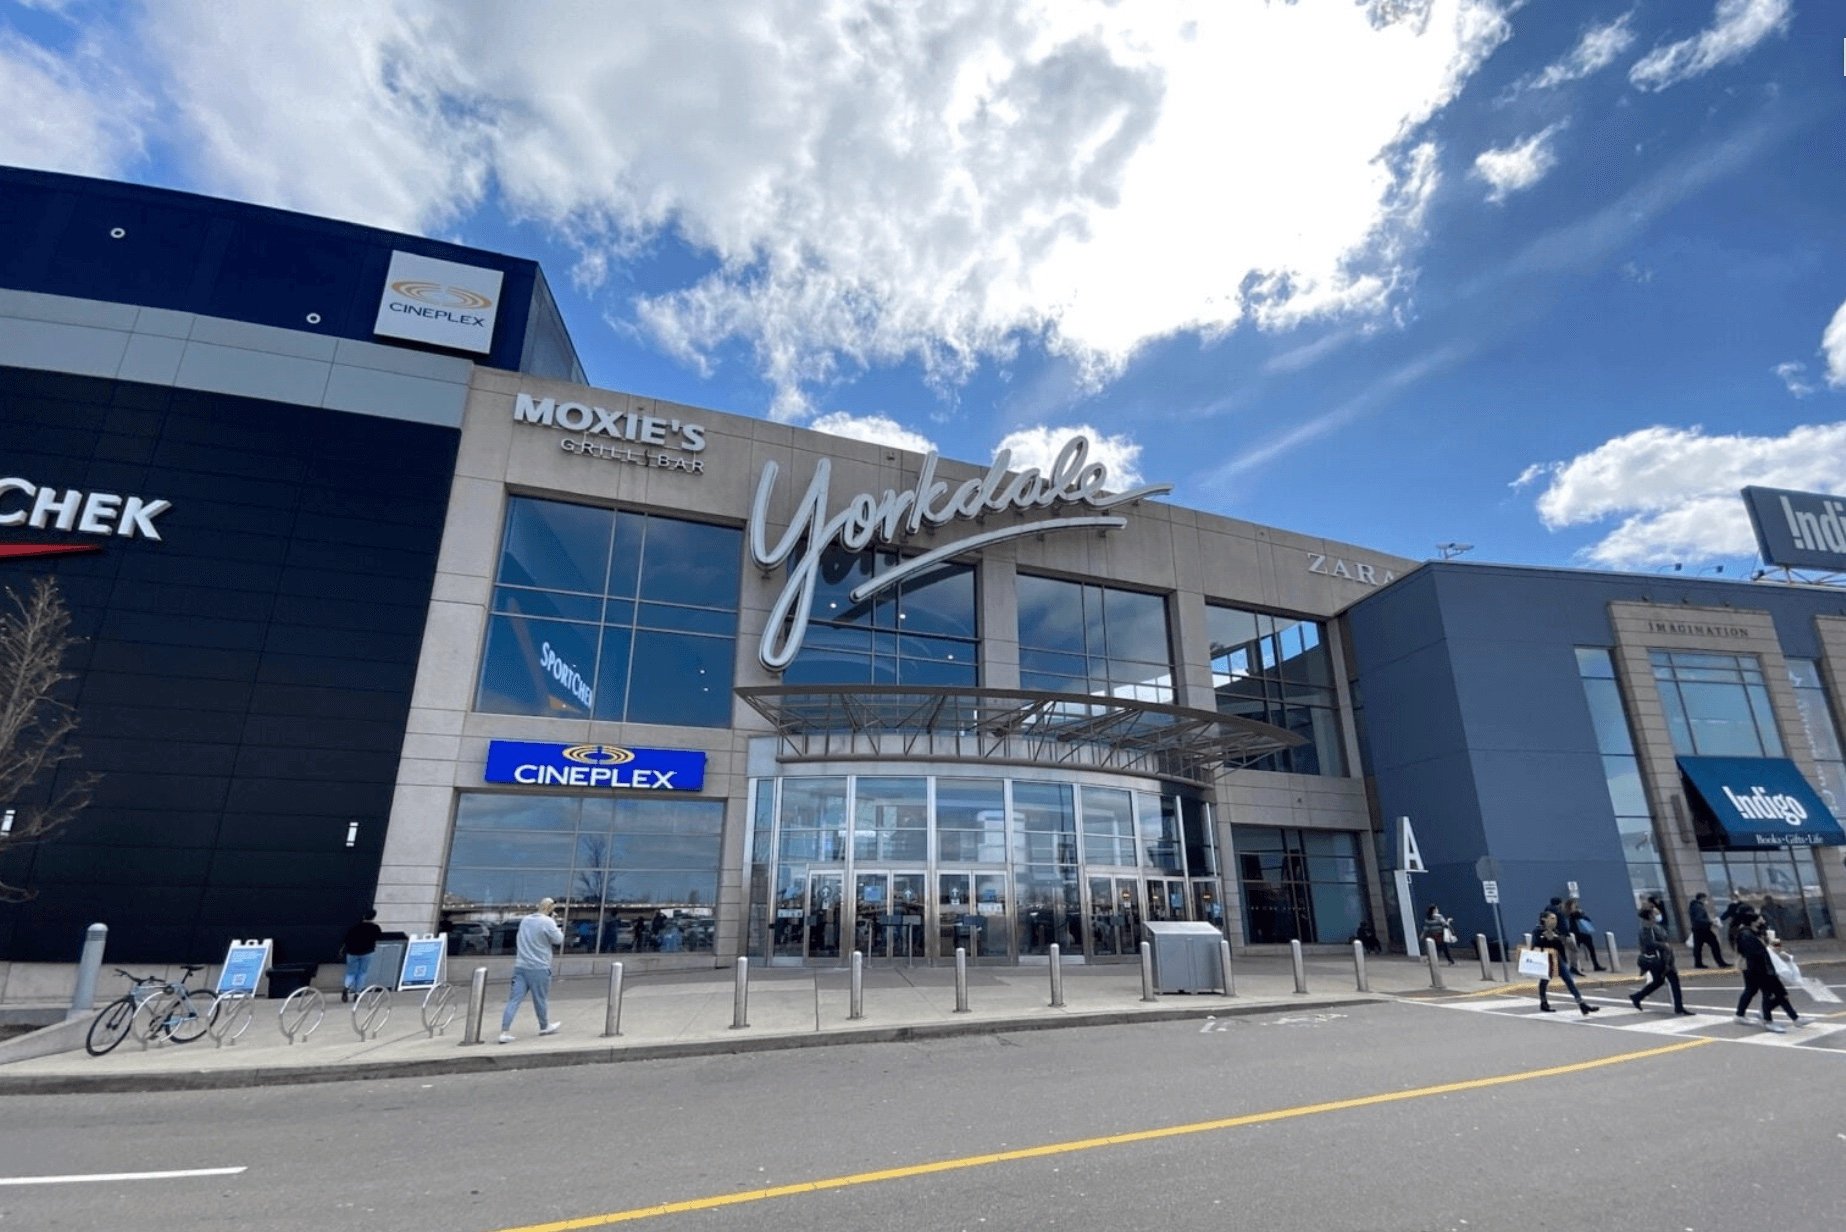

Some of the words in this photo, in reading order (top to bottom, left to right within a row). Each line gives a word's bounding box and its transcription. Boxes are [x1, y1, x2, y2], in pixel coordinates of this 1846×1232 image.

[389, 302, 485, 327] CINEPLEX
[514, 393, 706, 451] MOXIE'S
[561, 438, 638, 462] GRILL
[657, 453, 704, 474] BAR
[749, 435, 1175, 671] Yorkdale
[514, 764, 677, 789] CINEPLEX
[1721, 786, 1808, 826] Indigo
[1397, 816, 1425, 870] A
